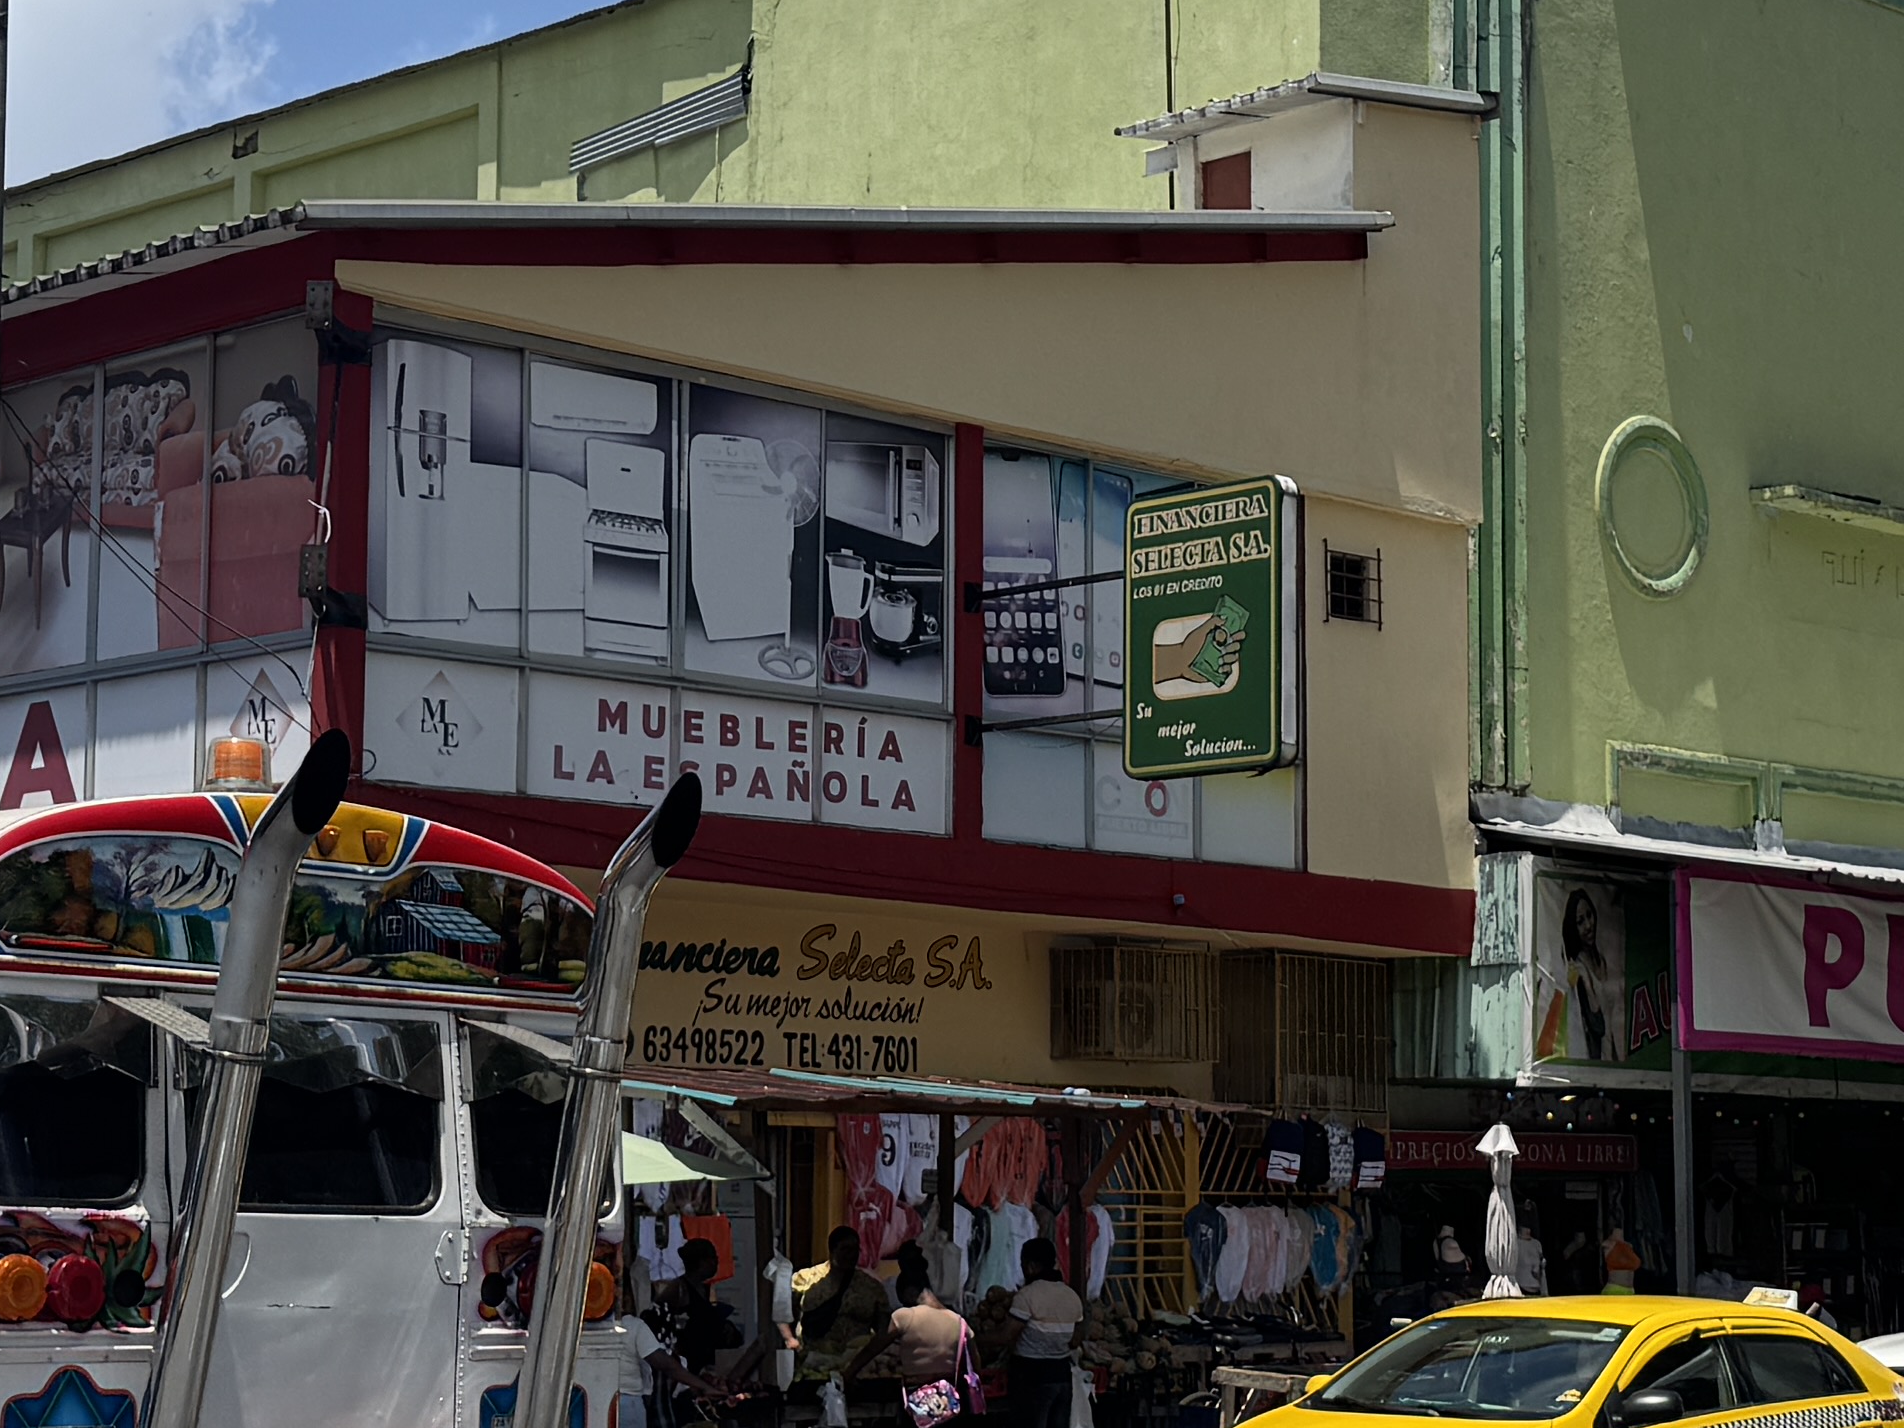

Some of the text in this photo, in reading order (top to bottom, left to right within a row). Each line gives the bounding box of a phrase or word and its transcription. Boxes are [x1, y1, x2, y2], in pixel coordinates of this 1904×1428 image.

[1134, 494, 1269, 539] FINANCIERA
[1131, 530, 1271, 578] SELECTA S.A.
[1133, 584, 1153, 600] LOS
[1166, 581, 1181, 595] EN
[1181, 574, 1224, 593] CREDITO
[1136, 702, 1152, 719] Su
[1157, 720, 1197, 739] mejor
[597, 698, 903, 763] MUEBLERÍA
[553, 745, 615, 784] LA
[797, 924, 916, 985] Selecta
[924, 934, 993, 991] S.A.
[746, 991, 812, 1029] mejor
[815, 985, 925, 1024] solución!
[643, 1025, 764, 1066] 63498522
[881, 1133, 896, 1167] 9
[1519, 1142, 1567, 1163] ZONA
[1483, 1335, 1510, 1345] TAXI
